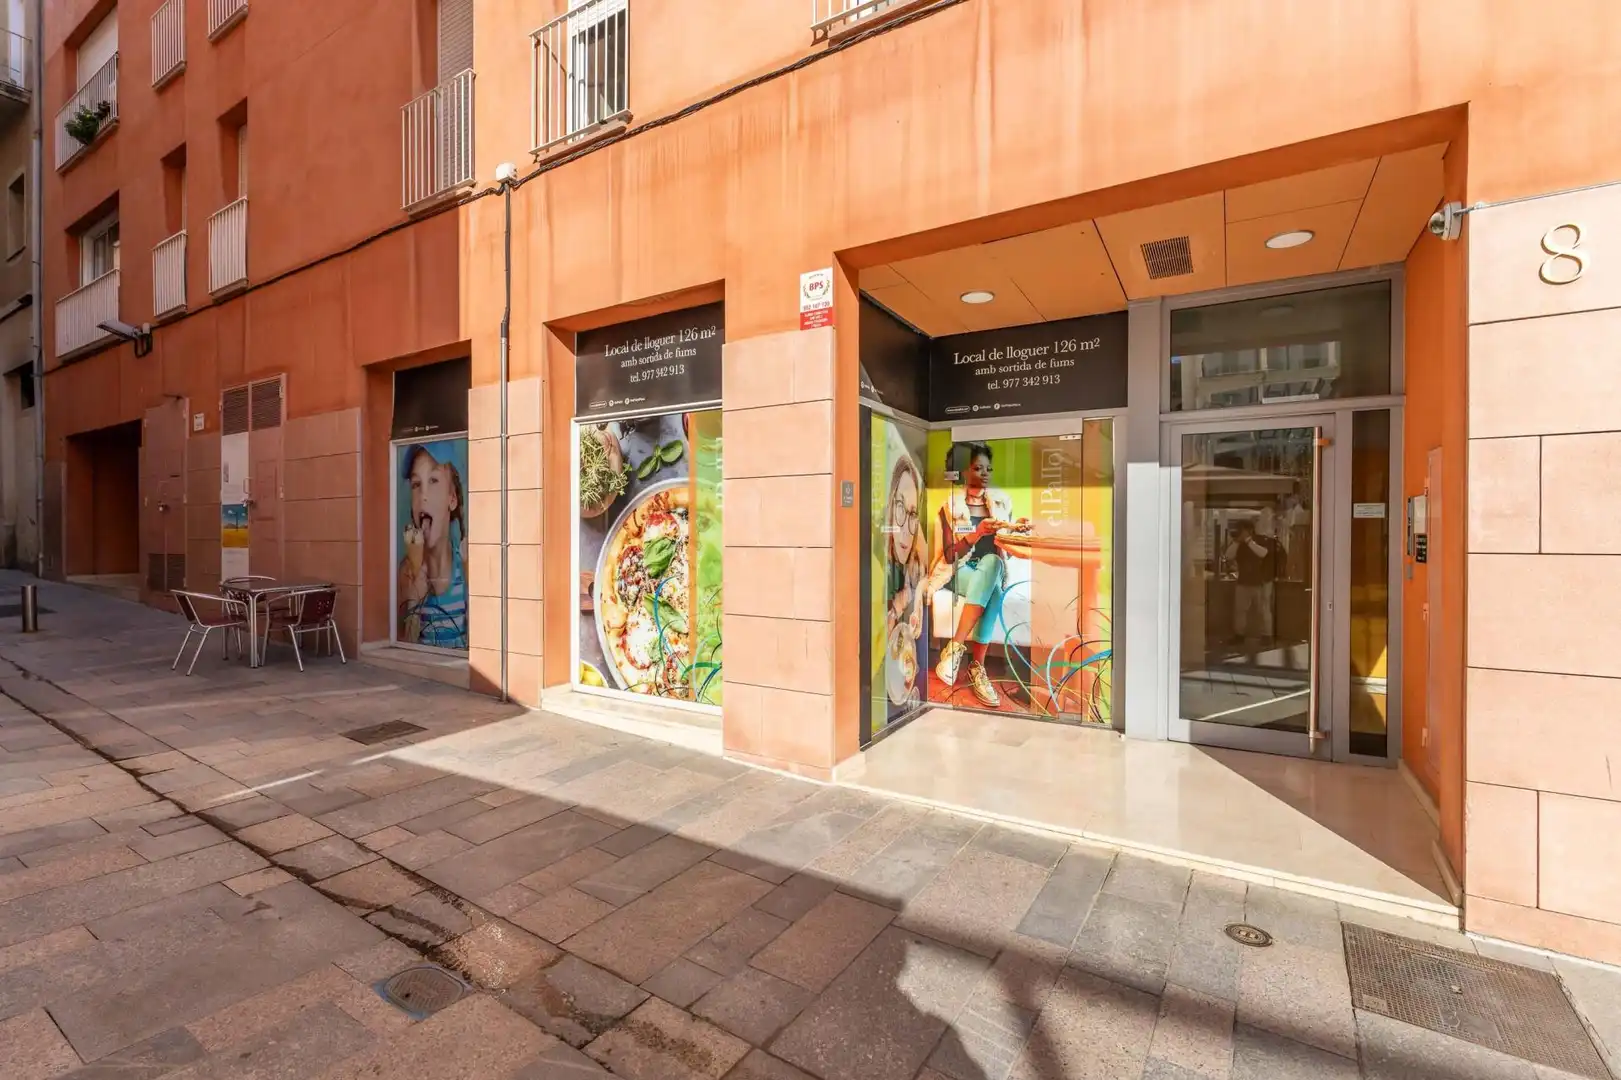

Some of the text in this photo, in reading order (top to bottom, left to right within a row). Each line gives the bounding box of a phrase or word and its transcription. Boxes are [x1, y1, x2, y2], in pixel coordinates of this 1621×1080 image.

[1538, 223, 1583, 286] 8
[809, 280, 824, 291] BPS
[605, 341, 629, 357] Local
[631, 339, 643, 353] de
[644, 335, 676, 351] lloguer
[679, 327, 698, 342] 126
[954, 350, 986, 365] Local
[988, 348, 1004, 361] de
[1006, 345, 1050, 361] lloguer
[1054, 339, 1077, 354] 126
[621, 347, 697, 368] amb sortida de fums
[975, 357, 1075, 376] amb sortida de fums
[630, 364, 685, 383] tel. 977 342 913
[987, 374, 1061, 390] tel. 977 342 913
